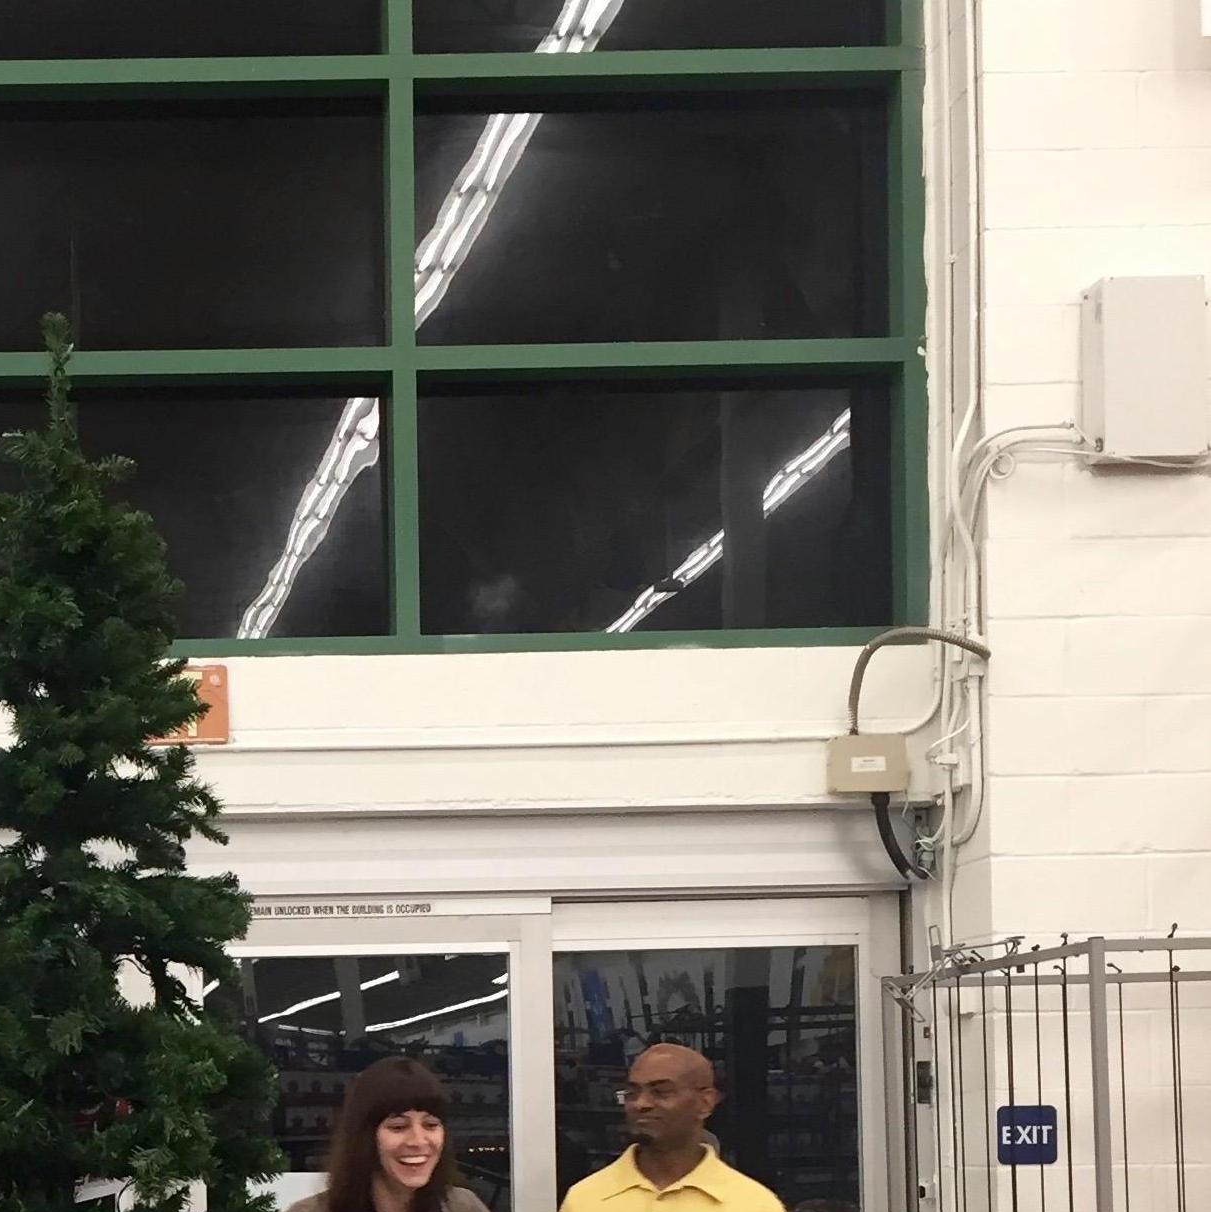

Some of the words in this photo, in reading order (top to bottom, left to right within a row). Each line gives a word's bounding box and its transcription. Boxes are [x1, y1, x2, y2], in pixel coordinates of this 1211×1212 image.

[274, 906, 311, 916] UNLOCKED
[313, 905, 334, 915] WHEN
[336, 905, 349, 915] THE
[352, 904, 384, 914] BUILDING
[386, 904, 394, 914] IS
[395, 903, 432, 914] OCCUPIED
[1002, 1125, 1053, 1145] EXIT
